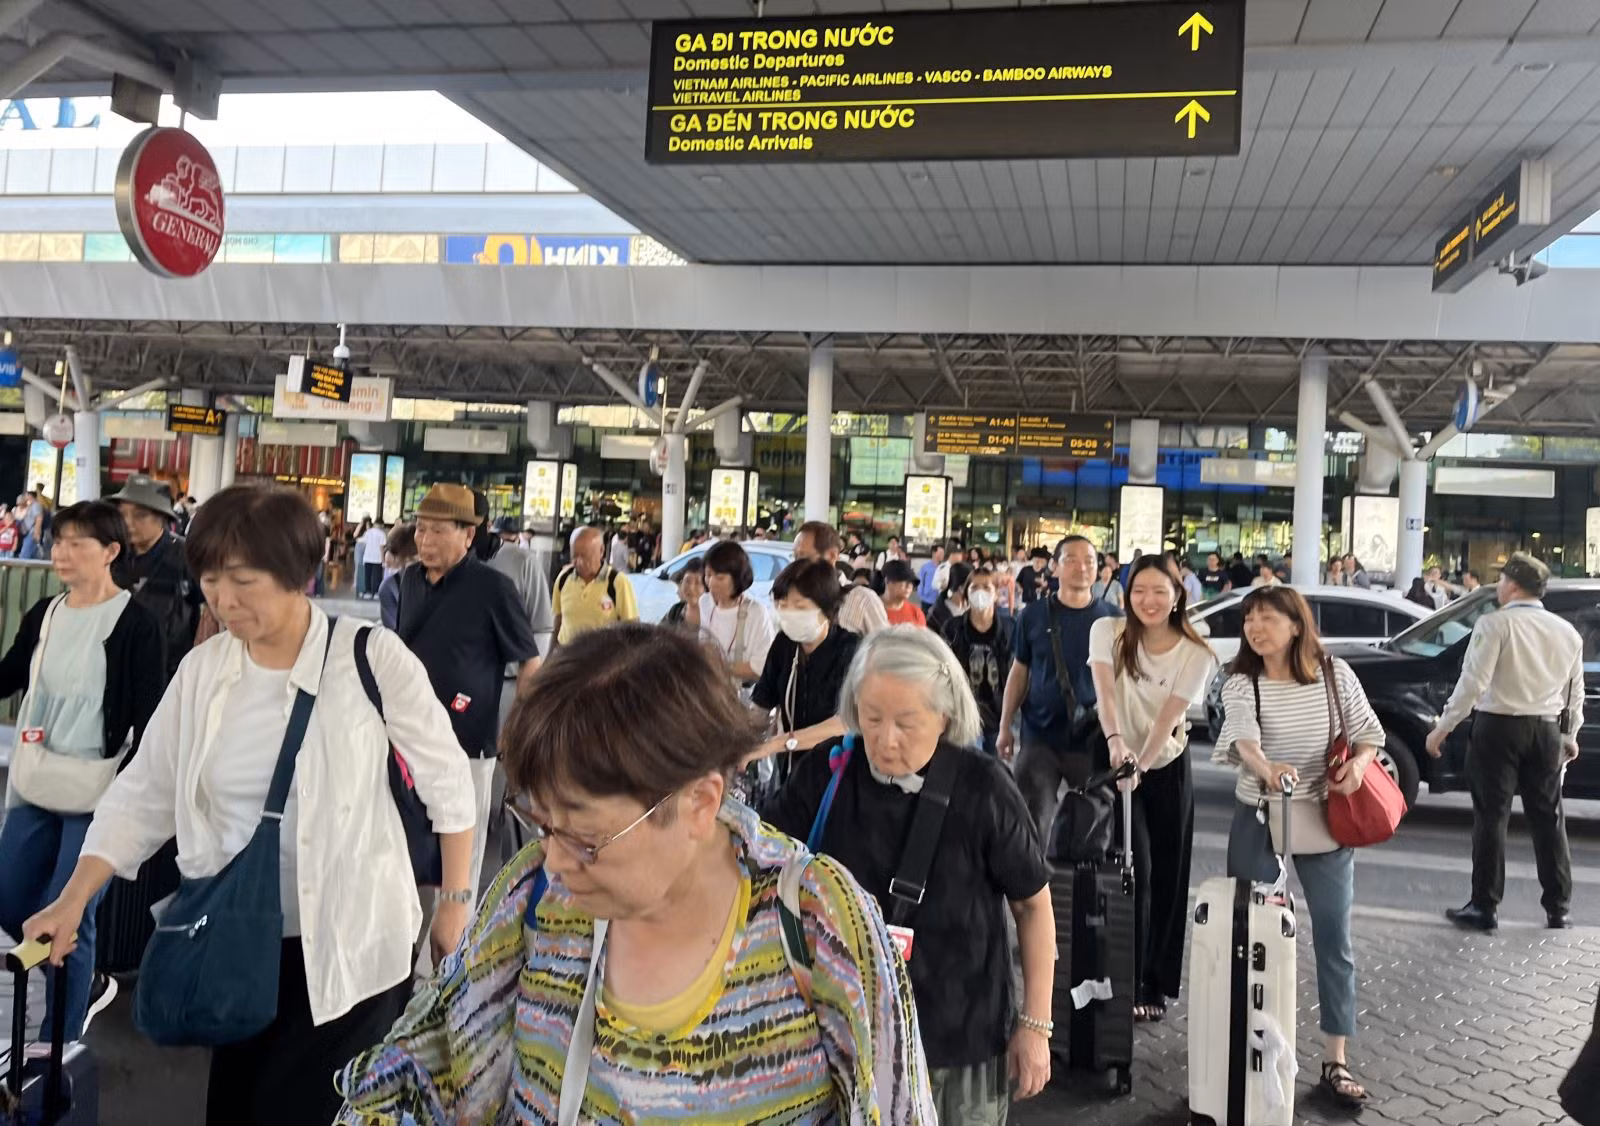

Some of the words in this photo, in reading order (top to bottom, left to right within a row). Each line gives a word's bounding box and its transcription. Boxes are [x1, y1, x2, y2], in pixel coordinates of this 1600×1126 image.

[675, 34, 707, 53] GA
[711, 32, 734, 52] ĐI
[739, 29, 818, 50] TRONG
[824, 22, 895, 47] NƯỚC
[673, 54, 749, 72] Domestic
[753, 52, 845, 72] Departures
[673, 77, 729, 91] VIETNAM
[730, 75, 789, 90] AIRLINES
[799, 73, 850, 88] PACIFIC
[852, 71, 914, 86] AIRLINES
[924, 69, 972, 84] VASCO
[983, 67, 1046, 82] BAMBOO
[1047, 65, 1113, 80] AIRWAYS
[672, 91, 740, 104] VIETRAVEL
[742, 89, 801, 103] AIRLINES
[670, 113, 702, 133] GA
[758, 111, 838, 131] TRONG
[844, 104, 915, 129] NƯỚC
[668, 135, 744, 152] Domestic
[748, 133, 813, 151] Arrivals
